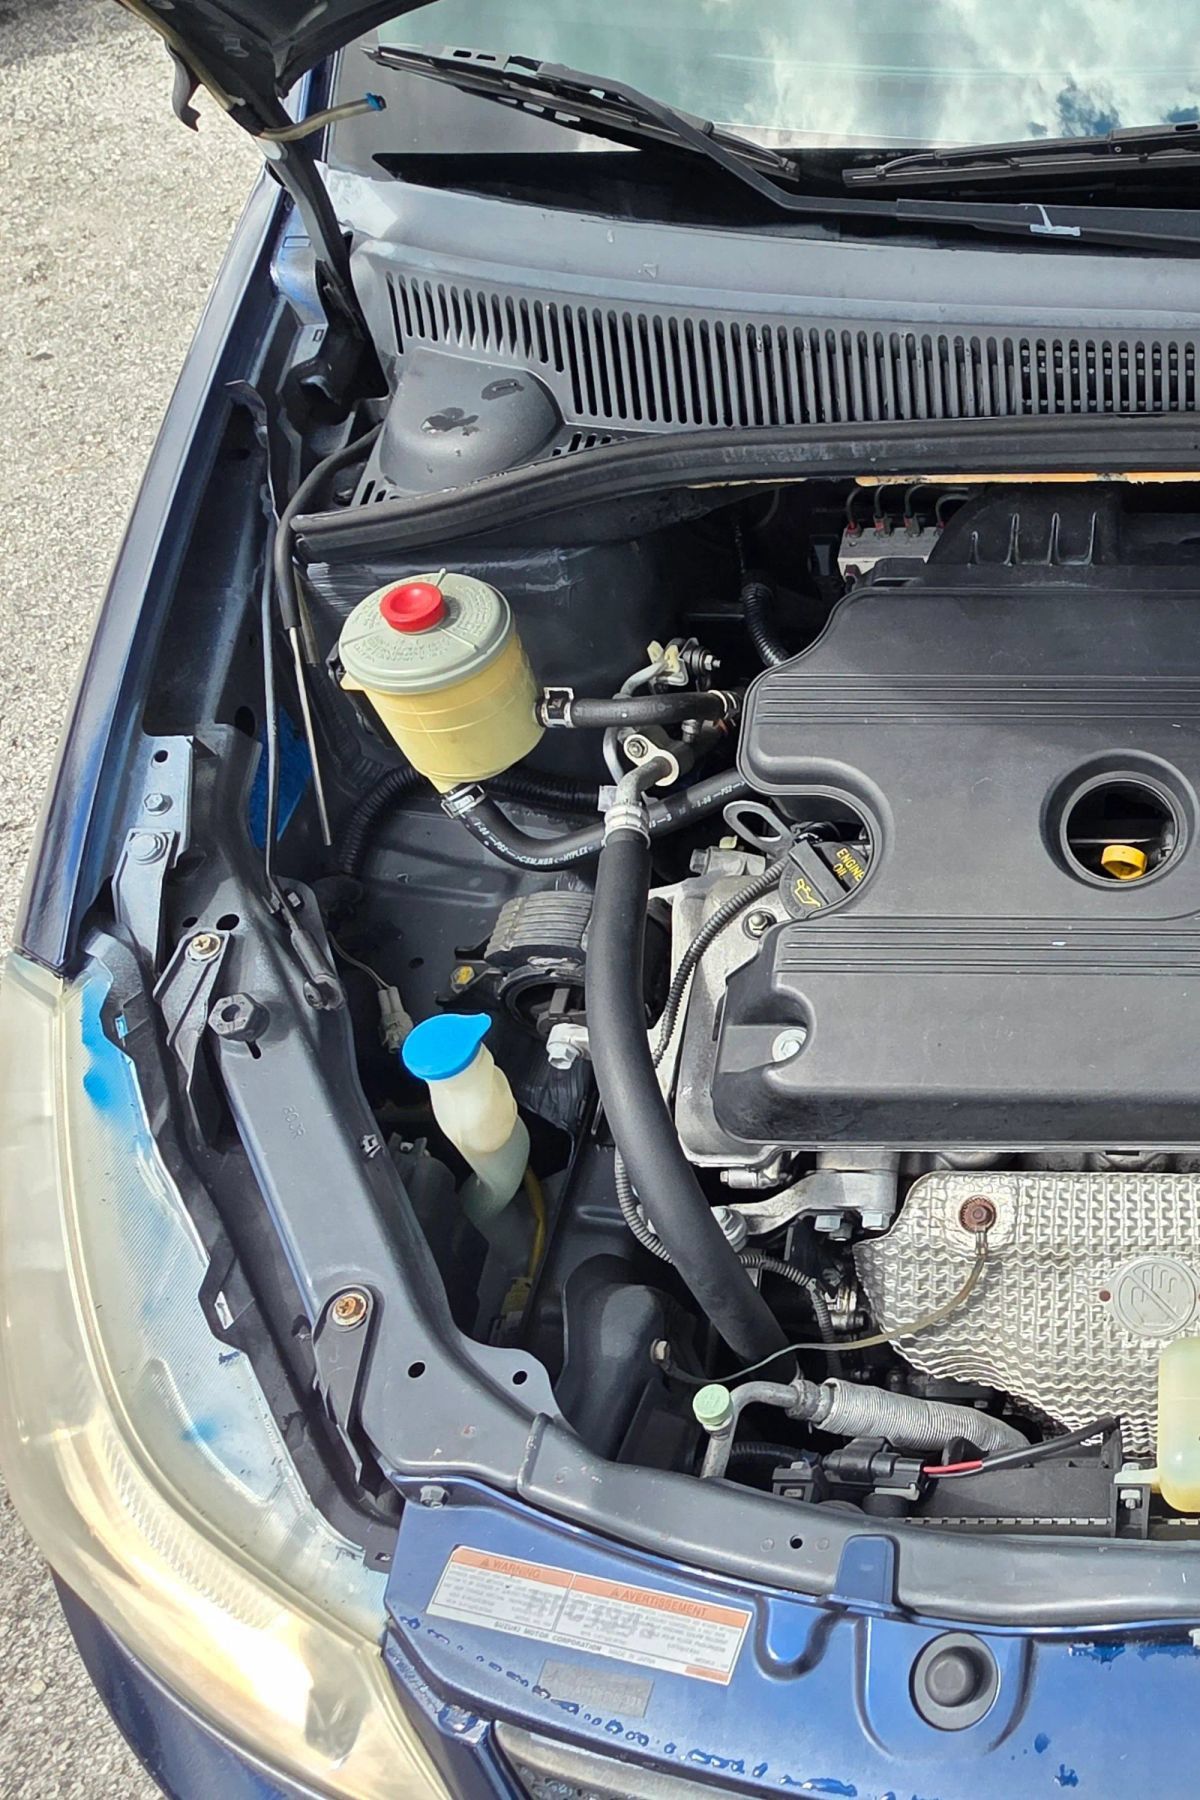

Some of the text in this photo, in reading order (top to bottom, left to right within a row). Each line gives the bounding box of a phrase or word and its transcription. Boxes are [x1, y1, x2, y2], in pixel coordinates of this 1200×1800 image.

[833, 863, 848, 880] OIL
[836, 847, 866, 882] ENGINE
[493, 1559, 542, 1578] WARNING
[622, 1590, 708, 1617] AVERTISSEMENT
[494, 1621, 521, 1634] SUZUKI
[523, 1627, 549, 1639] MOTOR
[552, 1632, 603, 1652] CORPORATION
